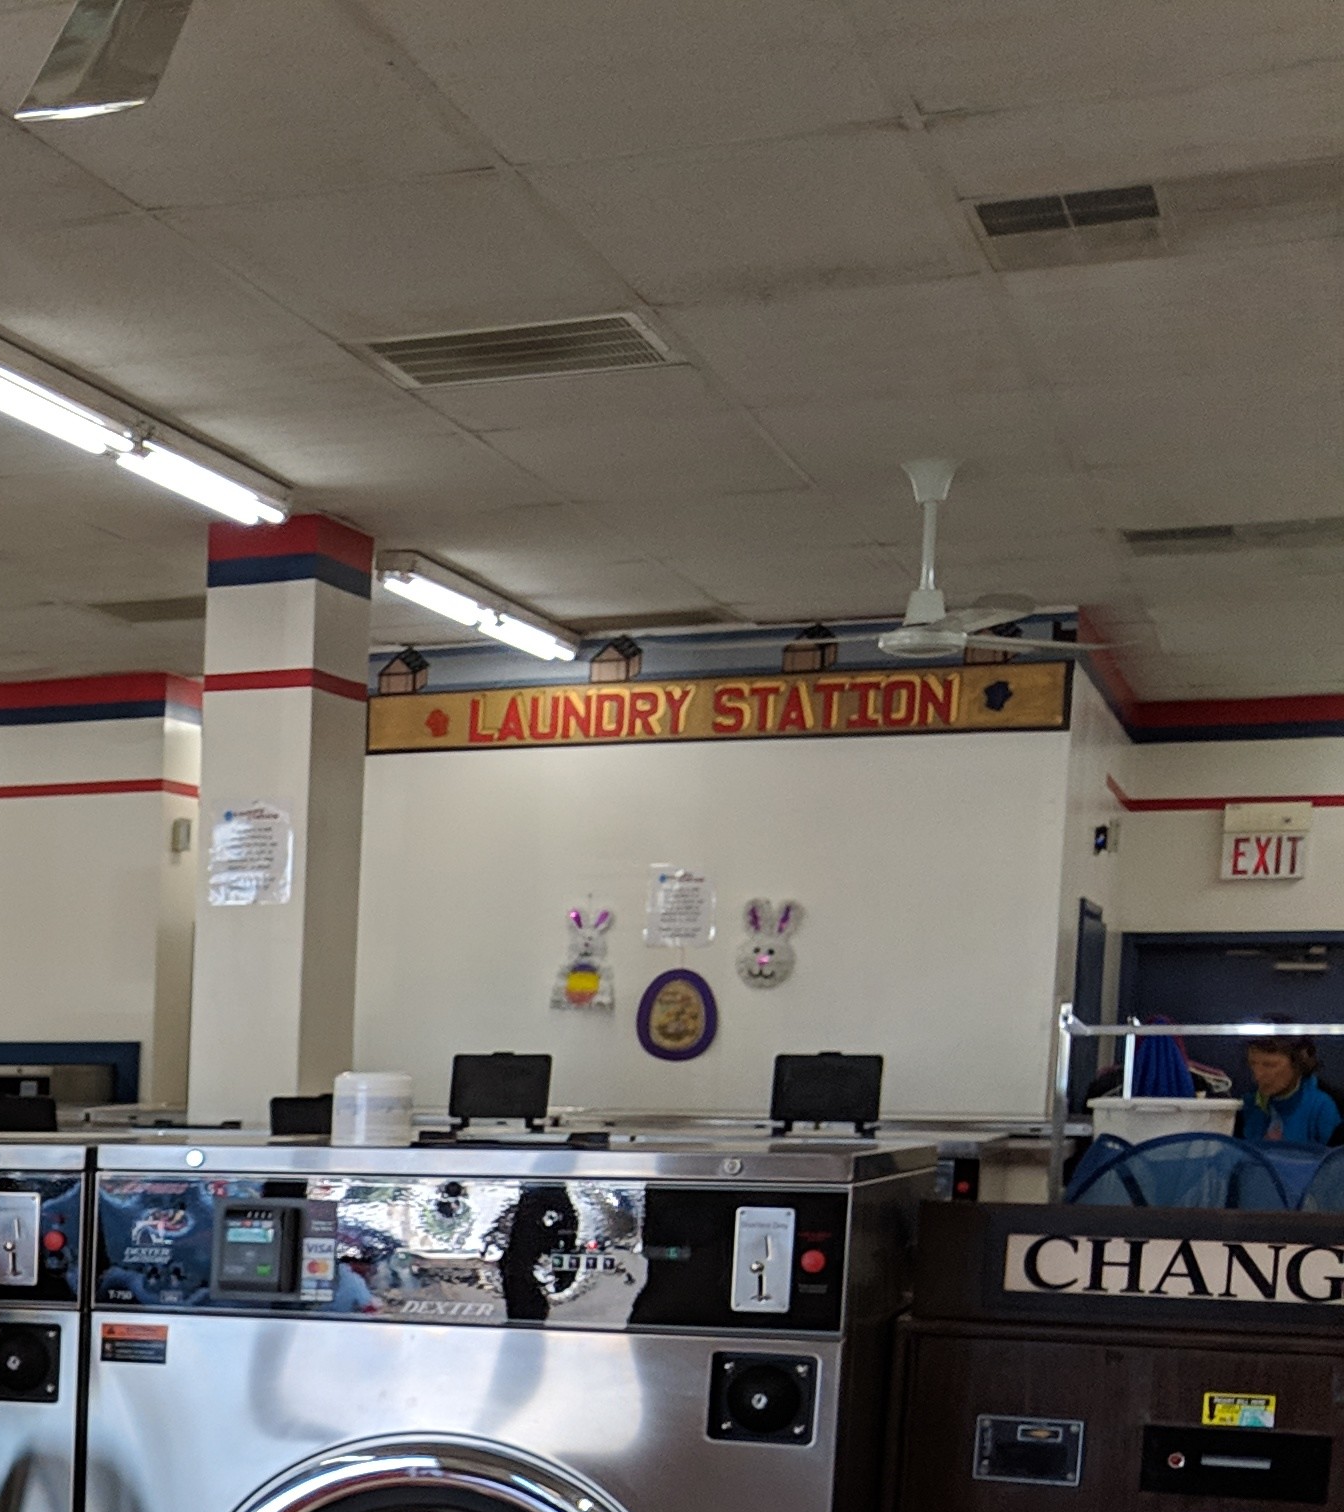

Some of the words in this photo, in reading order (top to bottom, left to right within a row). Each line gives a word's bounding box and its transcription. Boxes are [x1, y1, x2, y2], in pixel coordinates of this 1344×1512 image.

[469, 686, 696, 743] LAUNDRY
[713, 674, 961, 735] STATION
[1232, 836, 1305, 876] EXIT
[306, 1242, 333, 1254] VISA
[400, 1299, 495, 1317] DEXTER
